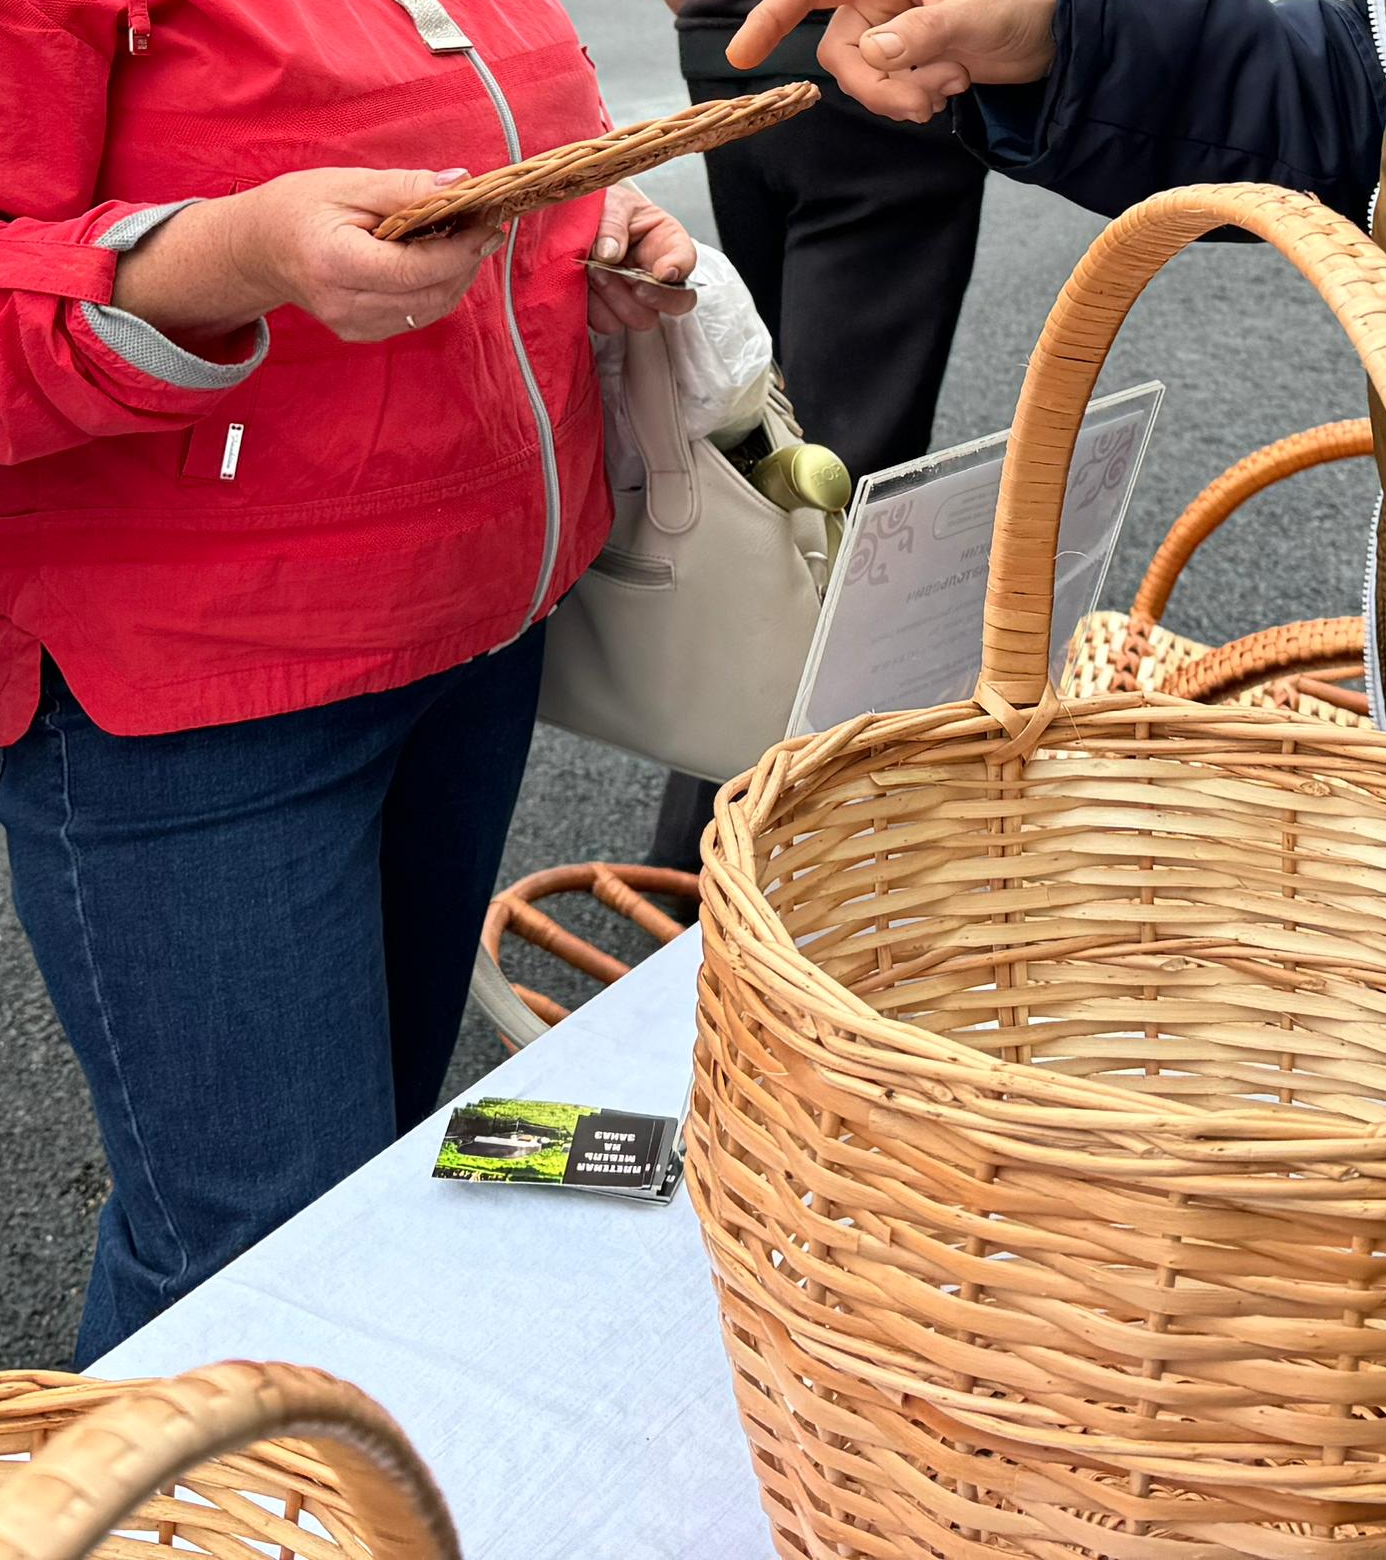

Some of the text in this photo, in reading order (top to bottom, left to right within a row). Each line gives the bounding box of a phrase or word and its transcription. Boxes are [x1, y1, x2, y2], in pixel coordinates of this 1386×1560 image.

[594, 1130, 636, 1142] ЗАКАЗ
[603, 1142, 622, 1152] НА
[584, 1152, 637, 1163] МЕБЕЛЬ
